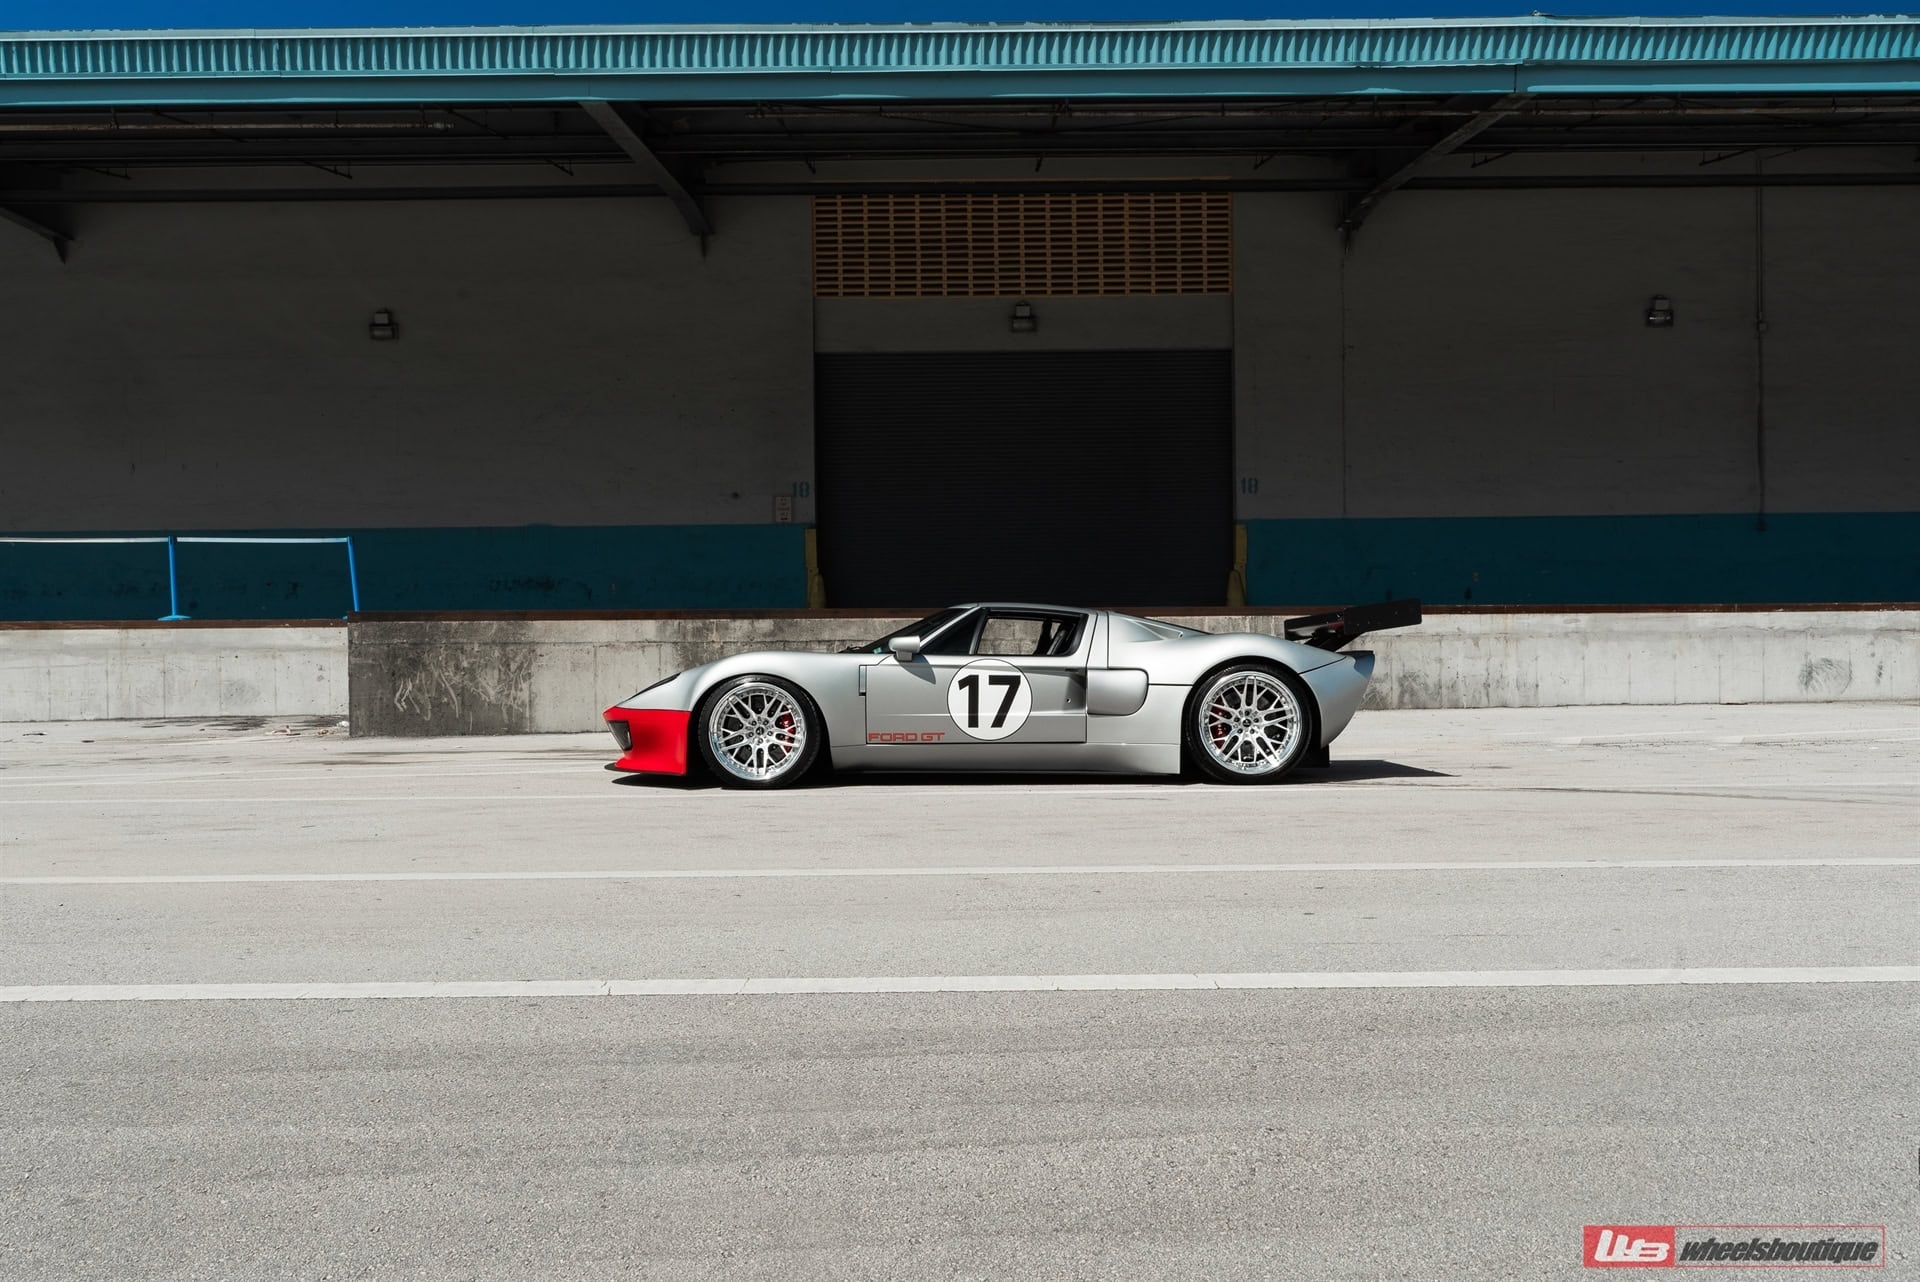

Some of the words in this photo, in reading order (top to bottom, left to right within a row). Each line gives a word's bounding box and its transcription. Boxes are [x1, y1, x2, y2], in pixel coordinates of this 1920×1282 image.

[957, 674, 1021, 728] 17
[868, 732, 918, 741] FORD
[920, 732, 945, 741] GT
